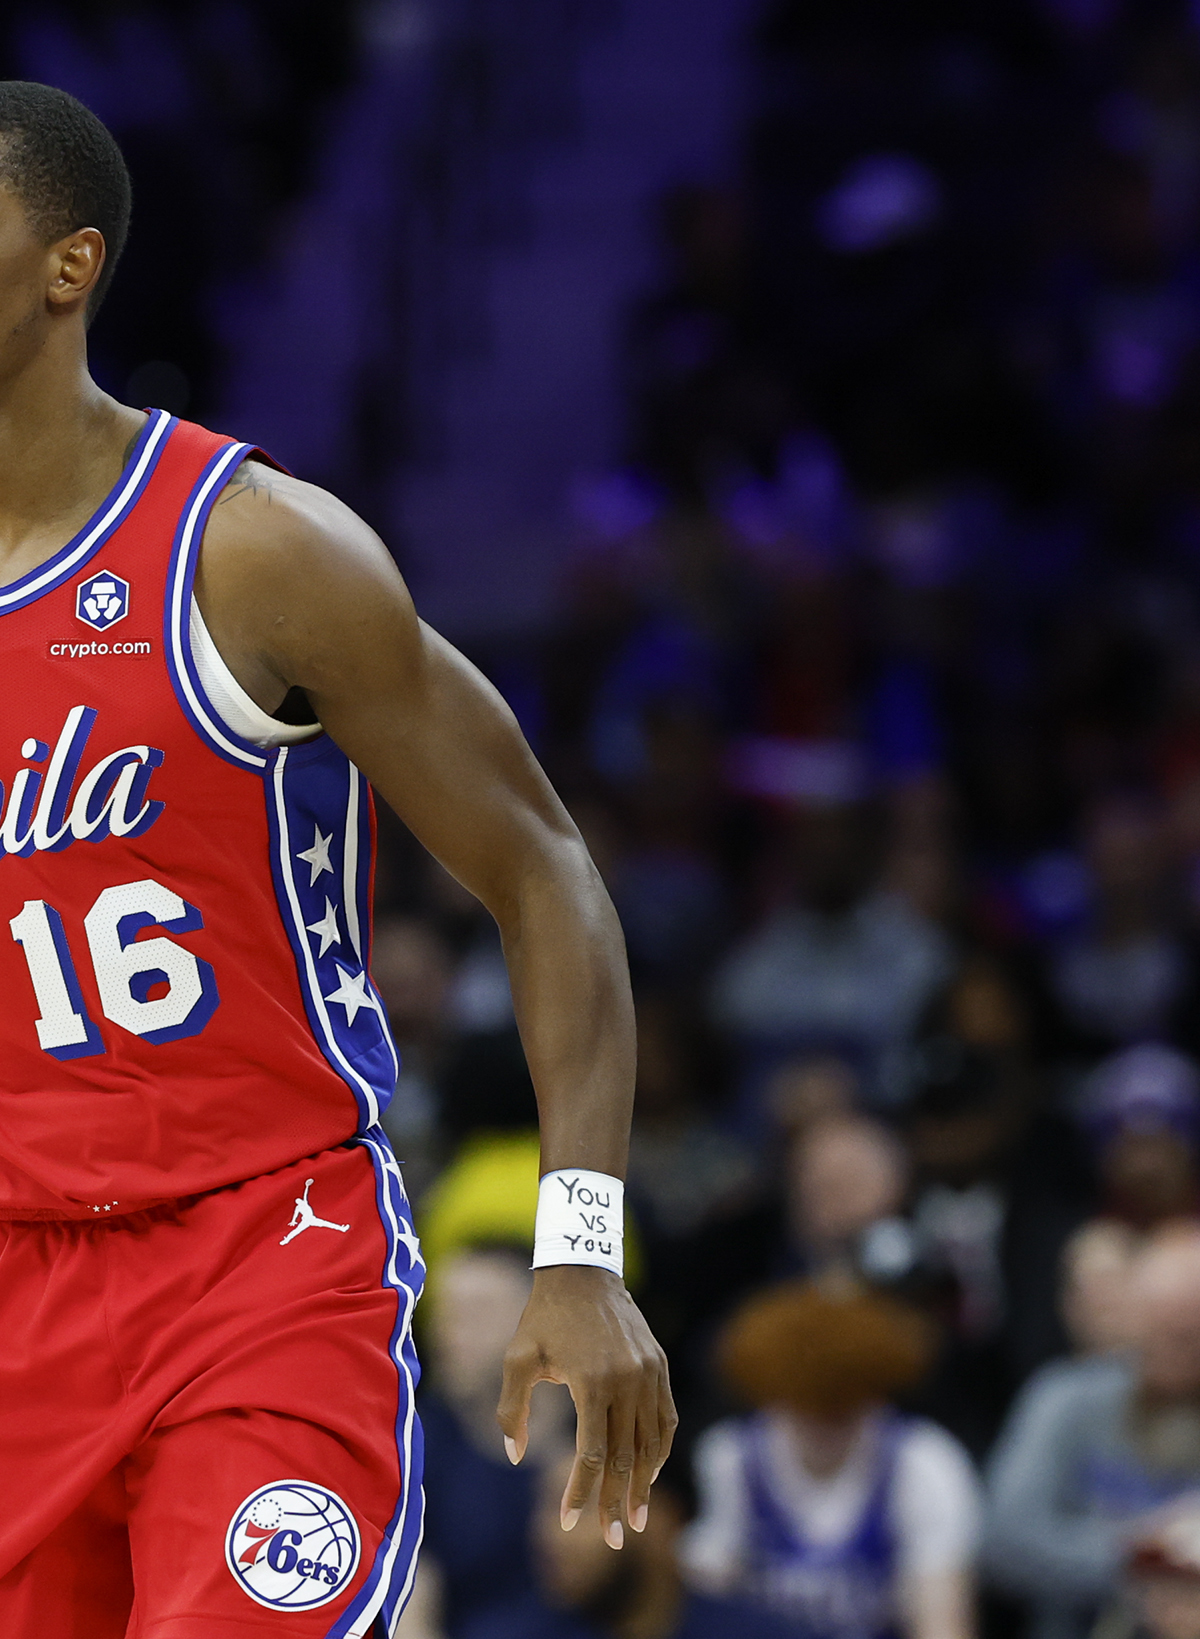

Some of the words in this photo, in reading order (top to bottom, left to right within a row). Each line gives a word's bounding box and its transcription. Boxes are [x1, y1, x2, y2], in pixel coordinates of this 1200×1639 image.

[49, 640, 151, 658] crypto.com
[9, 879, 220, 1061] 16
[238, 1519, 340, 1585] 76ers
